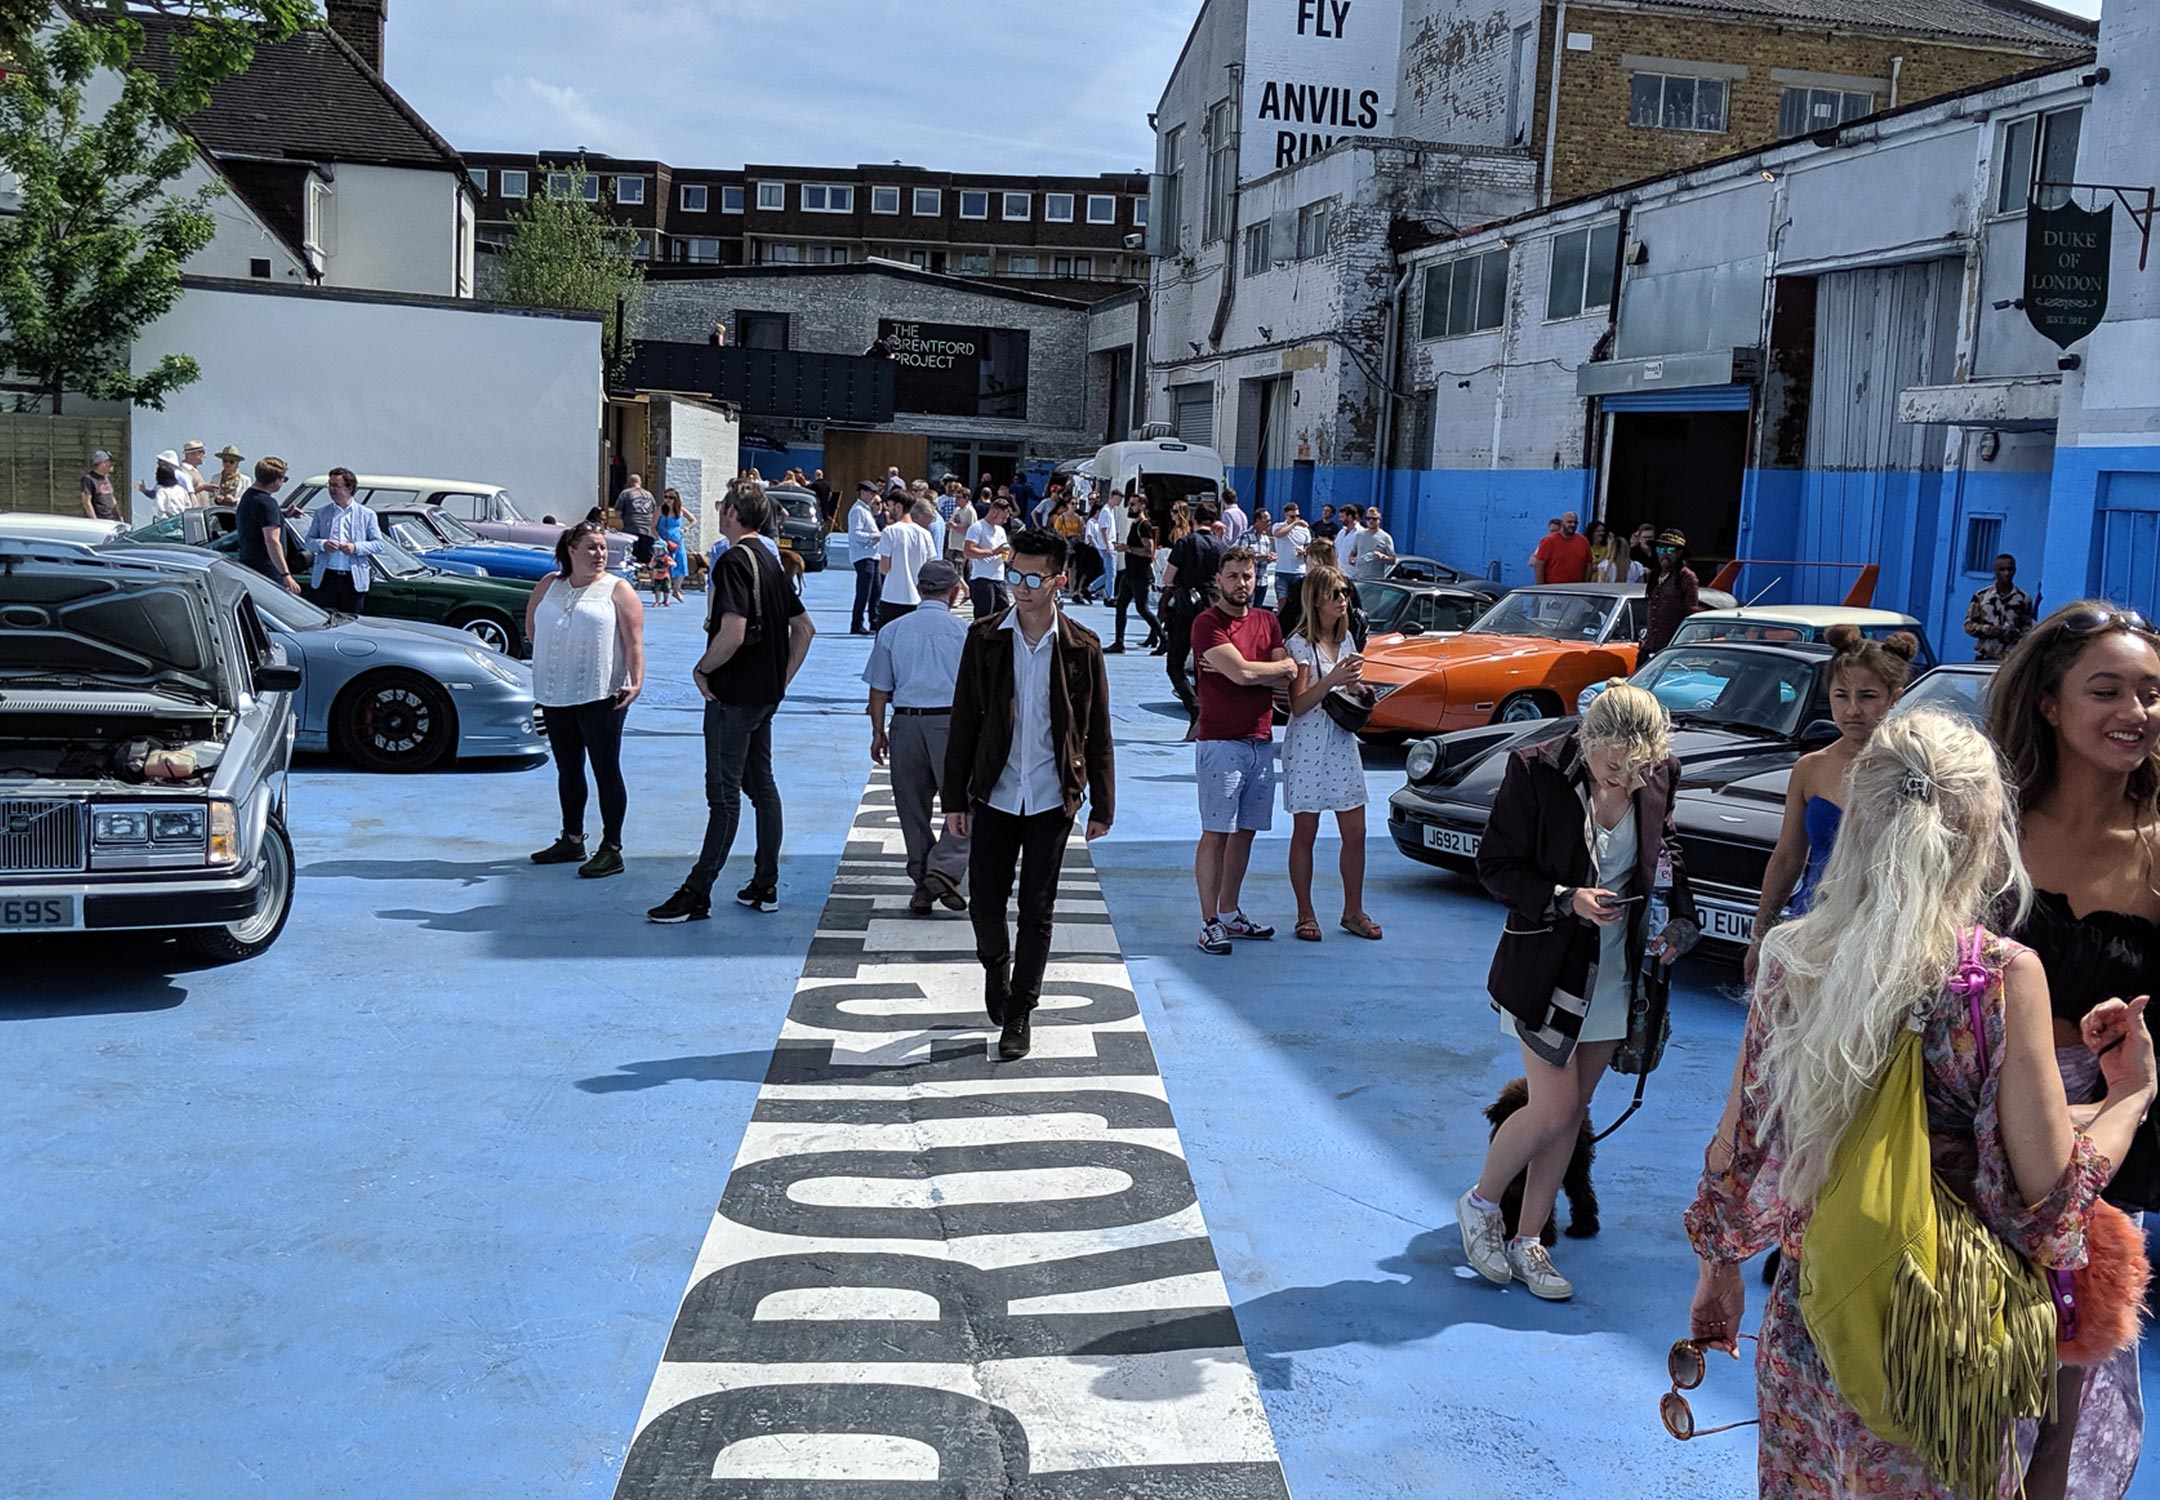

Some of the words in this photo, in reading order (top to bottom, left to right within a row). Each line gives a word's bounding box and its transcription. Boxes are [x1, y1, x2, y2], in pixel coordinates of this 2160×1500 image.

[1297, 0, 1350, 39] FLY
[1258, 81, 1379, 129] ANVILS
[1276, 131, 1351, 168] RIN
[2043, 230, 2097, 249] DUKE
[2058, 253, 2081, 268] OF
[2031, 274, 2102, 291] LONDON
[892, 323, 920, 338] THE
[1428, 829, 1460, 851] J692
[0, 900, 62, 924] 69S
[1715, 911, 1753, 939] EUW
[611, 937, 1291, 1500] PROJECT
